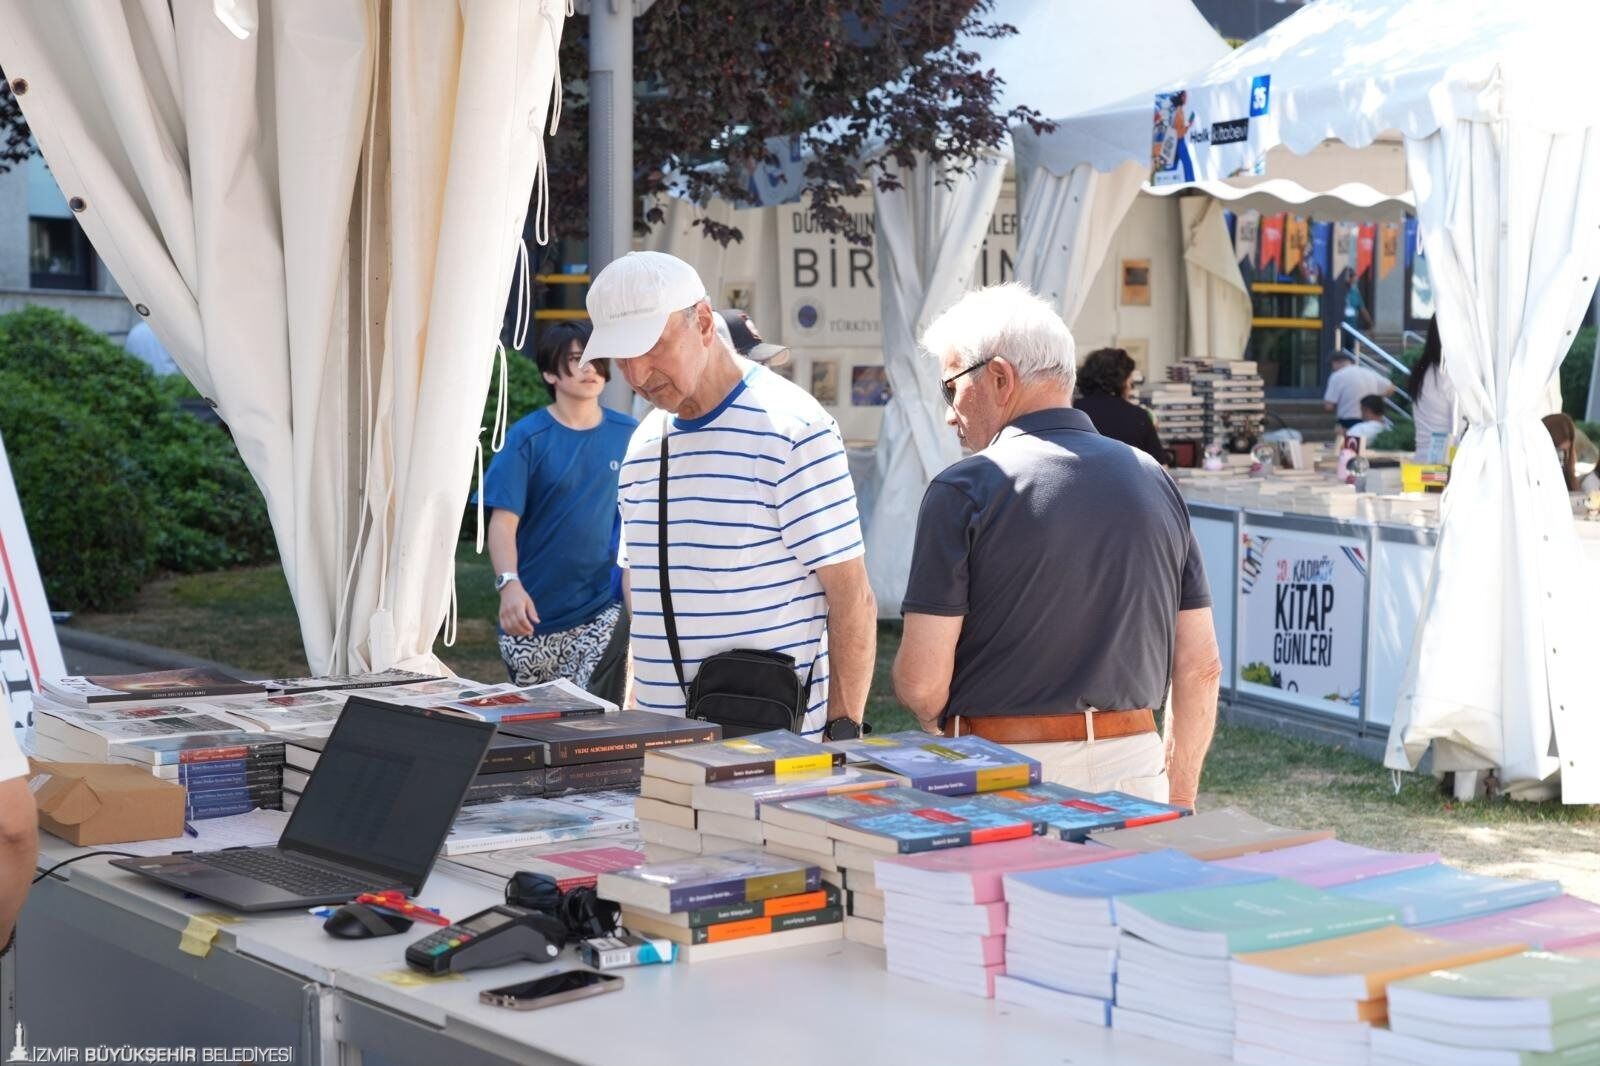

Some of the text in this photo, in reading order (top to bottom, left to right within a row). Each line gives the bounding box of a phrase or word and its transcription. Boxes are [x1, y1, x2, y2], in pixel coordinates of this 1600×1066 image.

[794, 238, 875, 288] BİR
[1275, 583, 1334, 632] KİTAP
[1274, 628, 1333, 667] GÜNLERİ
